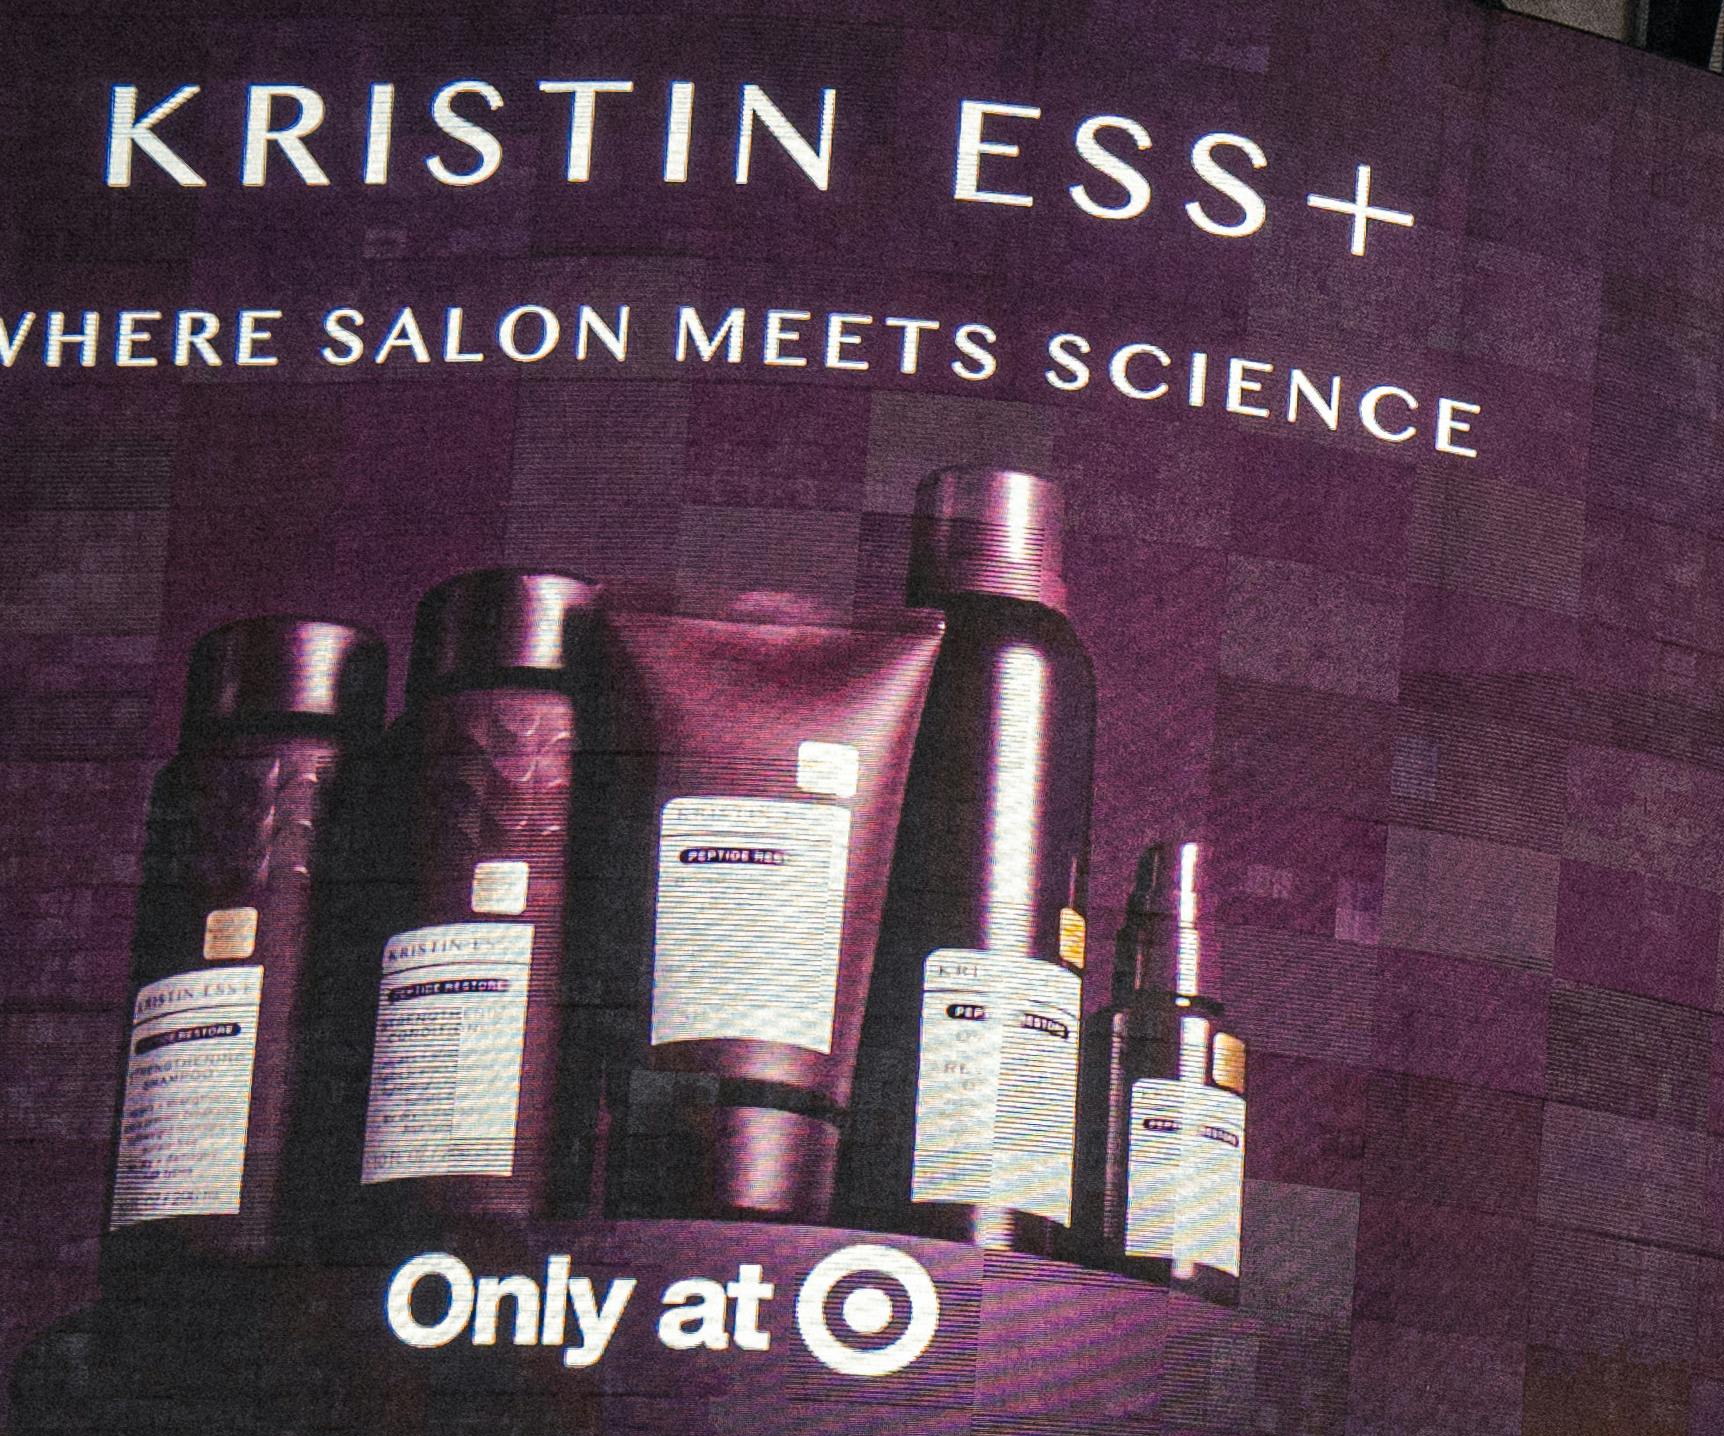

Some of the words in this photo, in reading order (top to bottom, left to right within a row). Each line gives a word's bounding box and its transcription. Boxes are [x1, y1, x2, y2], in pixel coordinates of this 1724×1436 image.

[106, 80, 838, 192] KRISTIN
[953, 99, 1415, 258] ESS+
[321, 303, 634, 366] SALON
[674, 308, 999, 383] MEETS
[1045, 331, 1485, 459] SCIENCE
[385, 1252, 638, 1369] Only
[657, 1262, 774, 1353] at
